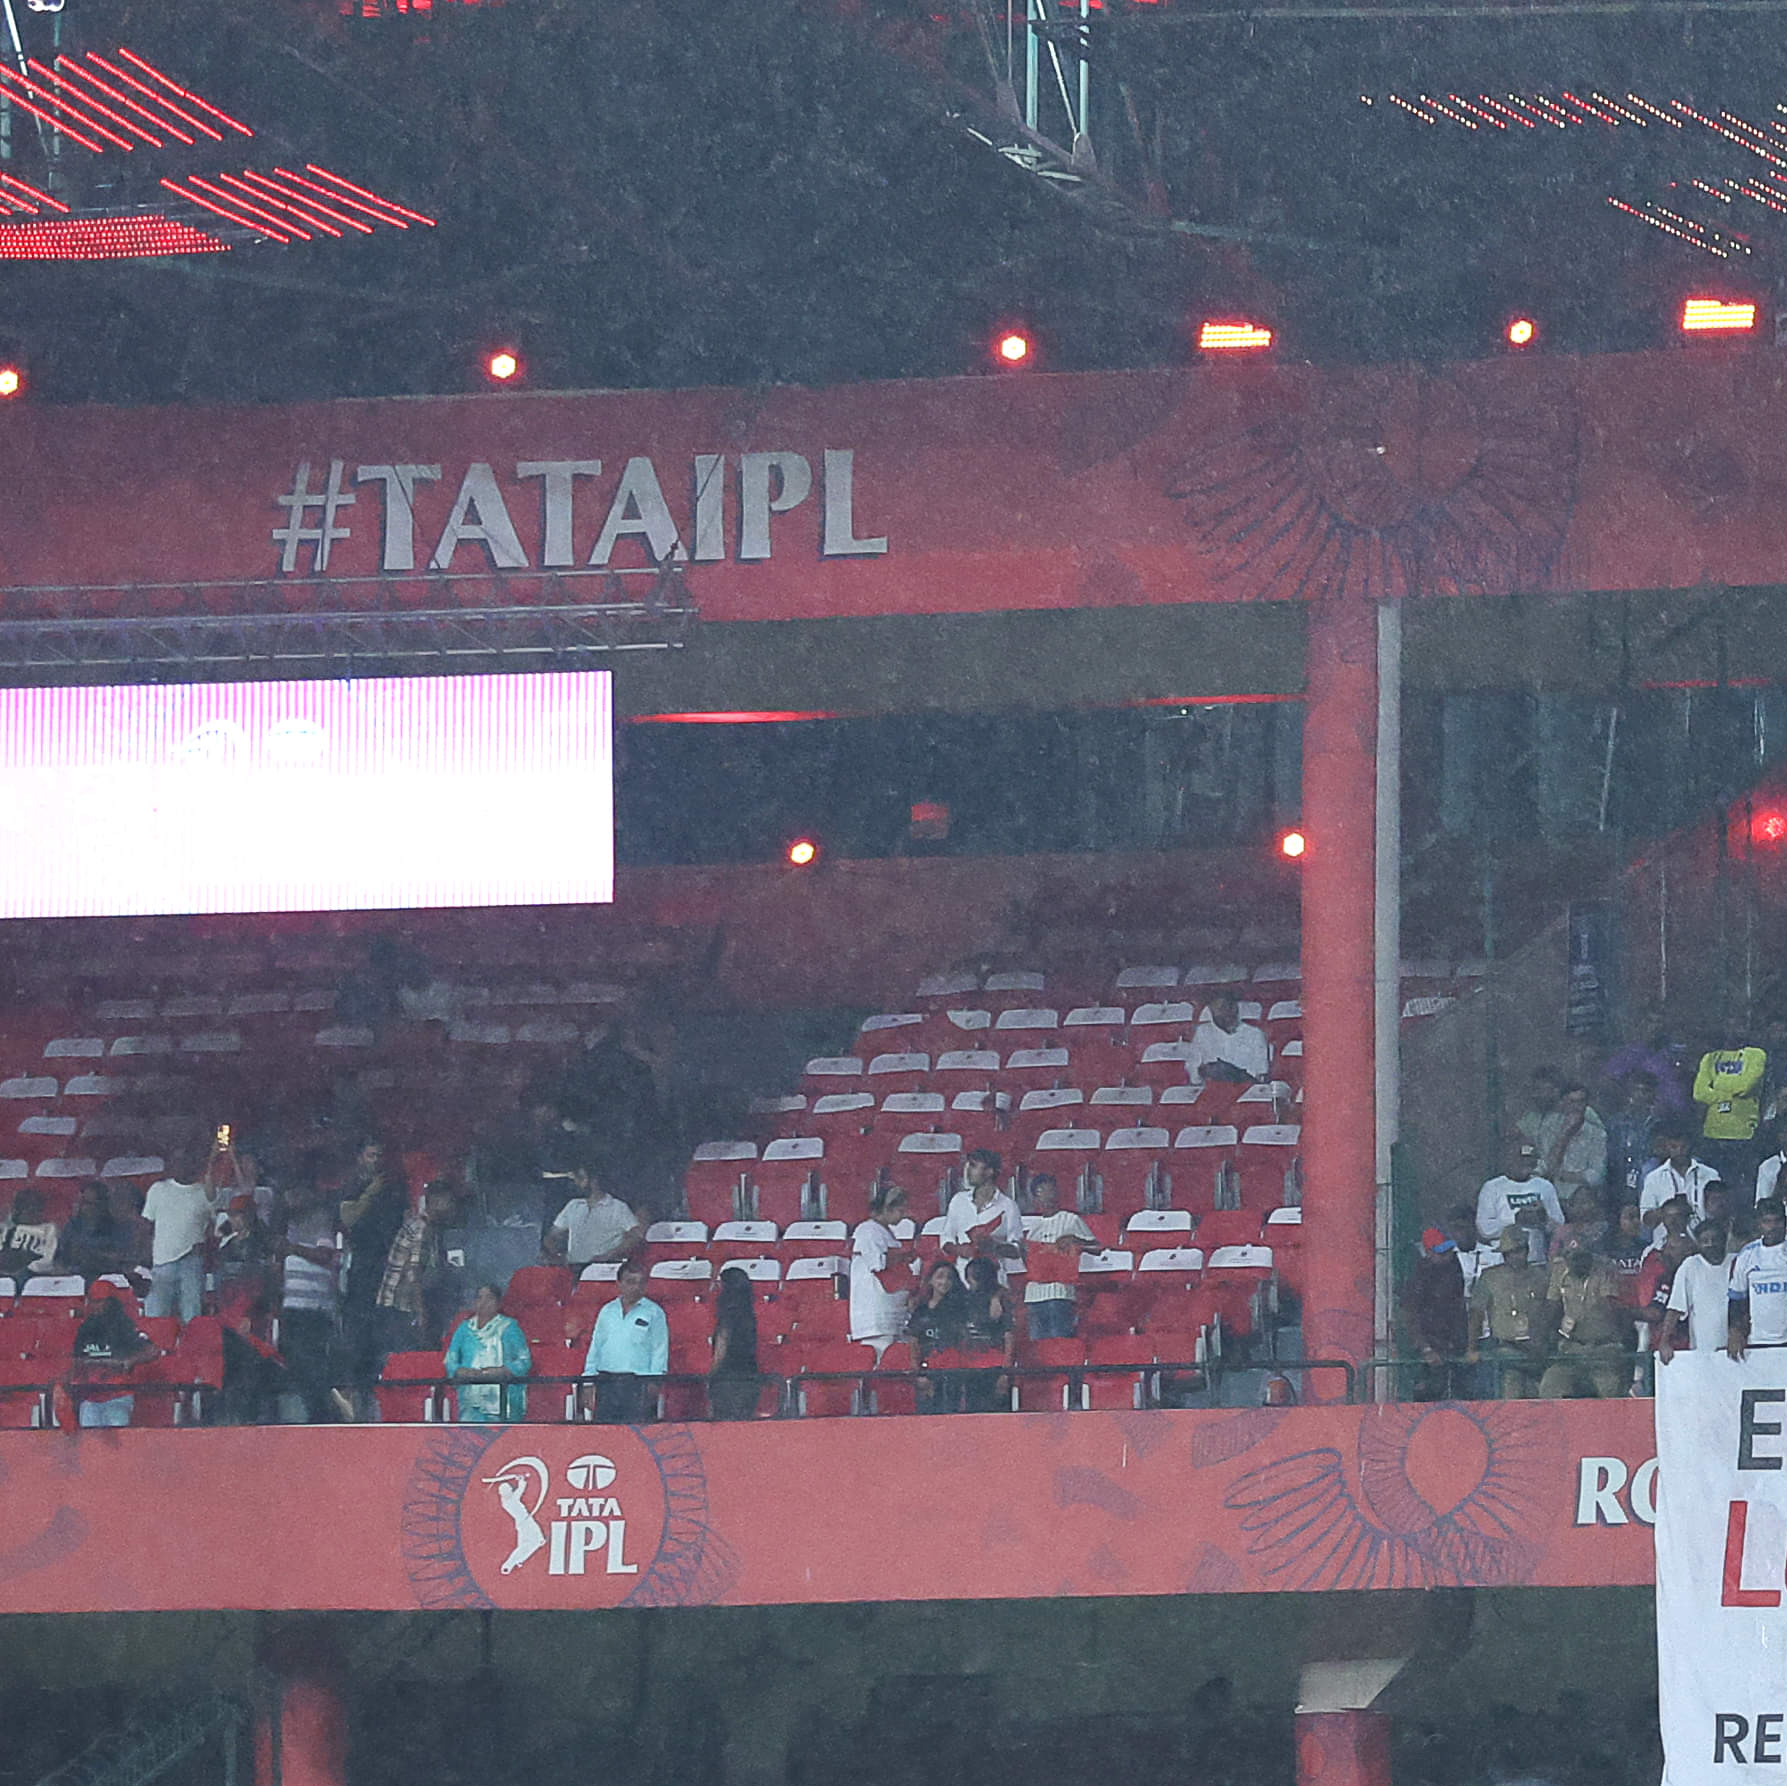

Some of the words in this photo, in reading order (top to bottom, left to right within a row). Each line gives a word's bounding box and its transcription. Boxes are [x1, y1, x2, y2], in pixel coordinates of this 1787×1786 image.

[272, 450, 889, 571] #TATAIPL
[556, 1498, 621, 1516] TATA
[548, 1520, 638, 1574] IPL
